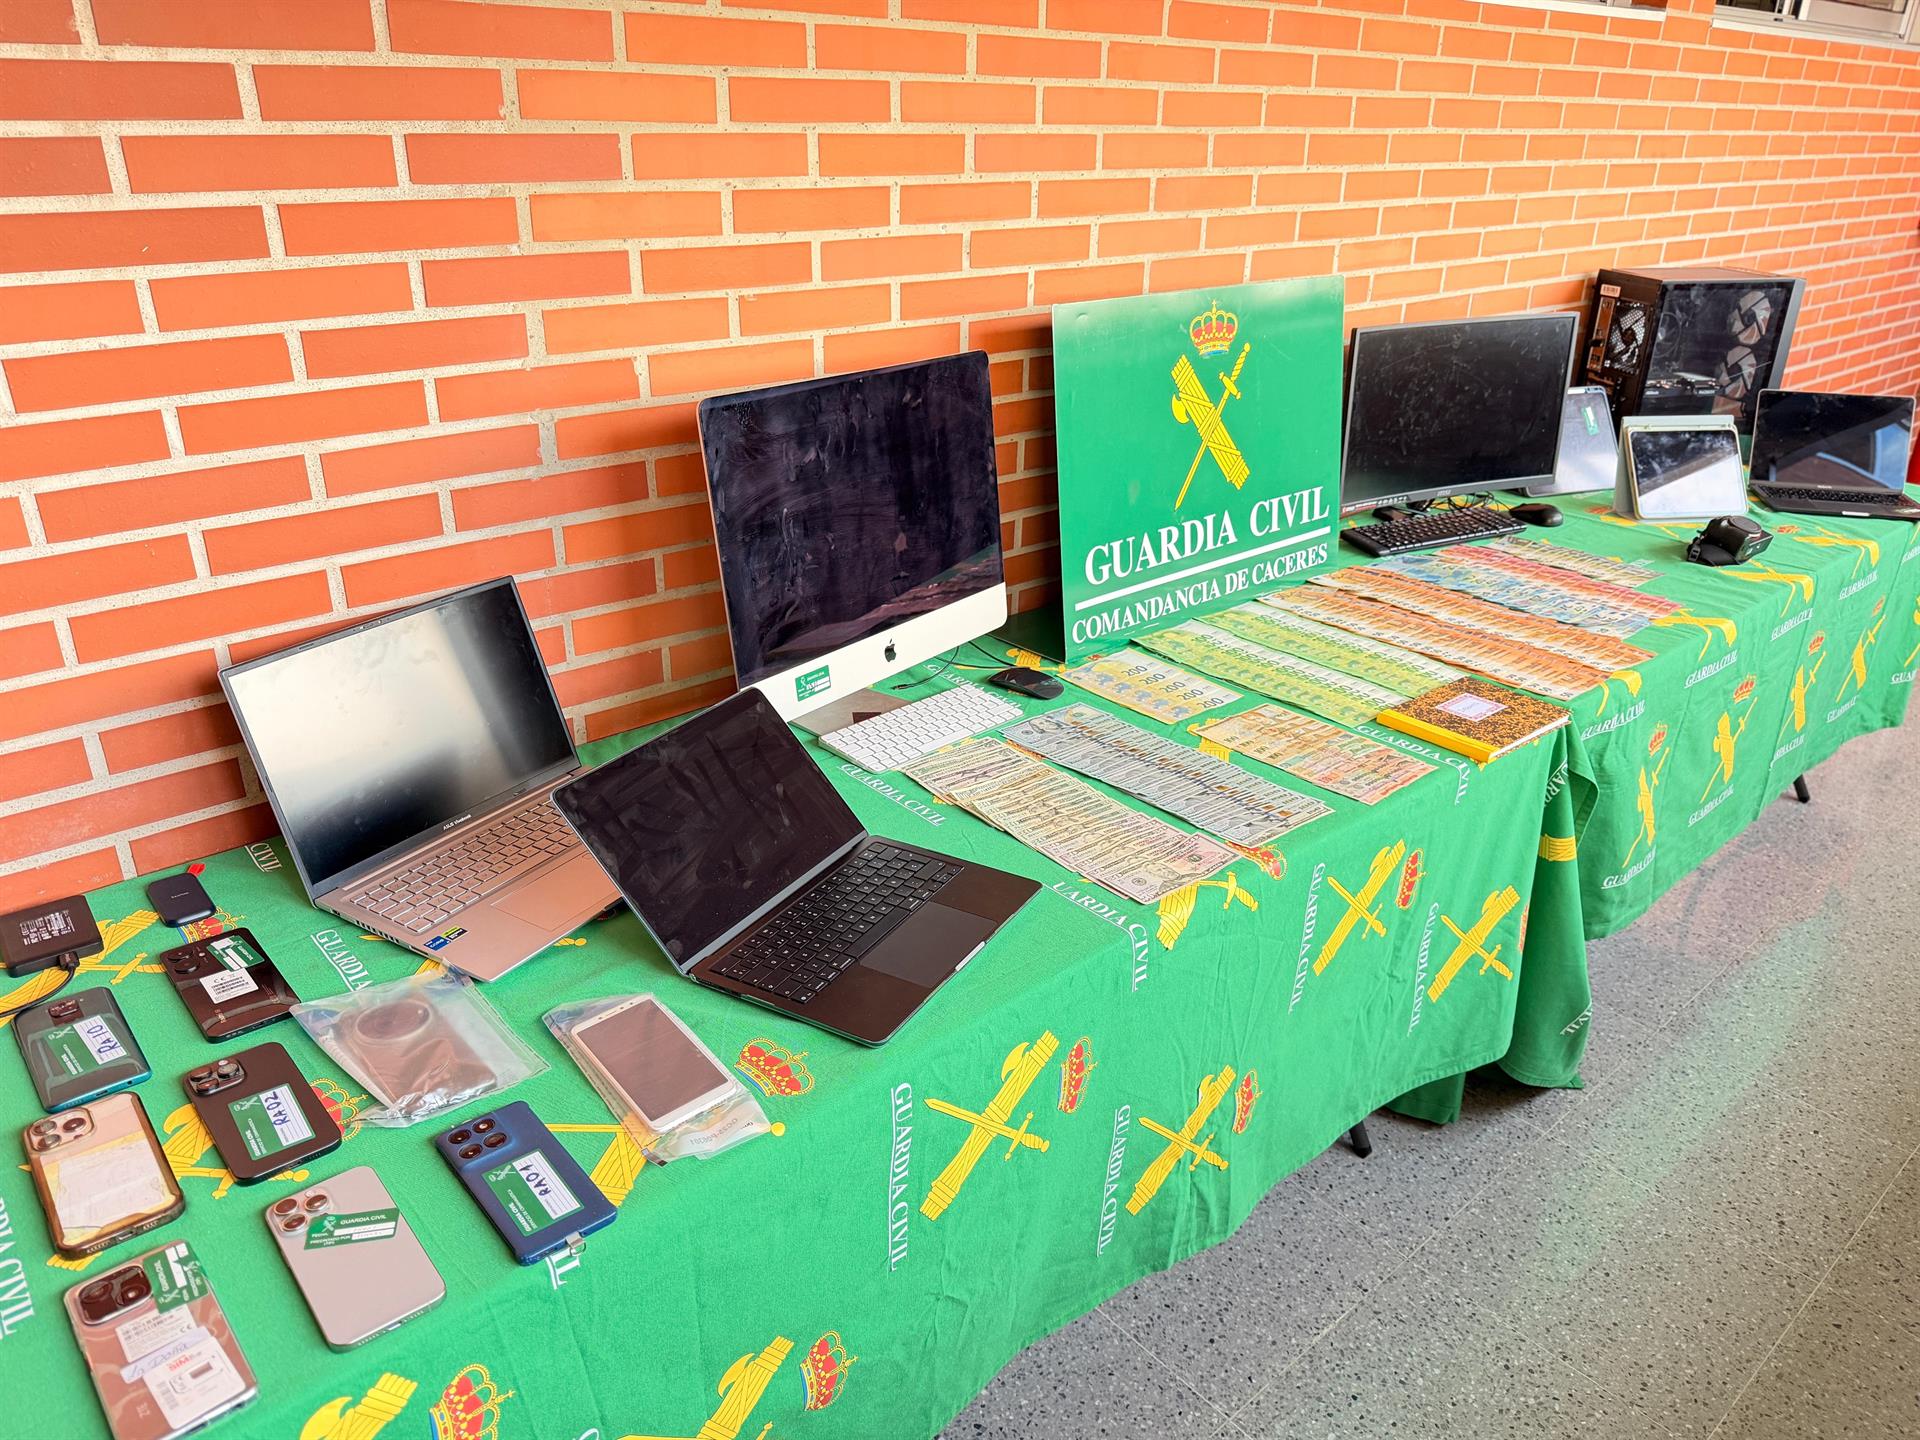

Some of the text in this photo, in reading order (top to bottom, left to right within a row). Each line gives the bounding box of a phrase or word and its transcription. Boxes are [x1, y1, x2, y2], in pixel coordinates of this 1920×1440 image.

[1085, 486, 1330, 586] GUARDIA CIVIL
[1072, 543, 1329, 644] COMANDANCIA DE CACERES
[1121, 665, 1148, 677] 200
[1140, 673, 1166, 685] 200
[1161, 681, 1186, 693] 200
[1177, 688, 1204, 701] 200
[1197, 697, 1225, 709] 200
[840, 764, 946, 826] GUARDIA CIVIL
[1356, 726, 1471, 805] GUARDIA CIVIL
[251, 842, 283, 872] CIVIL
[316, 929, 374, 991] GUARDIA
[1128, 923, 1149, 992] CIVIL
[1289, 863, 1326, 1015] GUARDIA CIVIL
[1408, 902, 1440, 1036] GUARDIA CIVIL
[264, 1091, 290, 1126] RA02
[519, 1164, 552, 1196] RA01
[891, 1082, 913, 1271] GUARDIA CIVIL
[1099, 1104, 1131, 1257] GUARDIA CIVIL
[340, 1216, 369, 1226] GUARDIA
